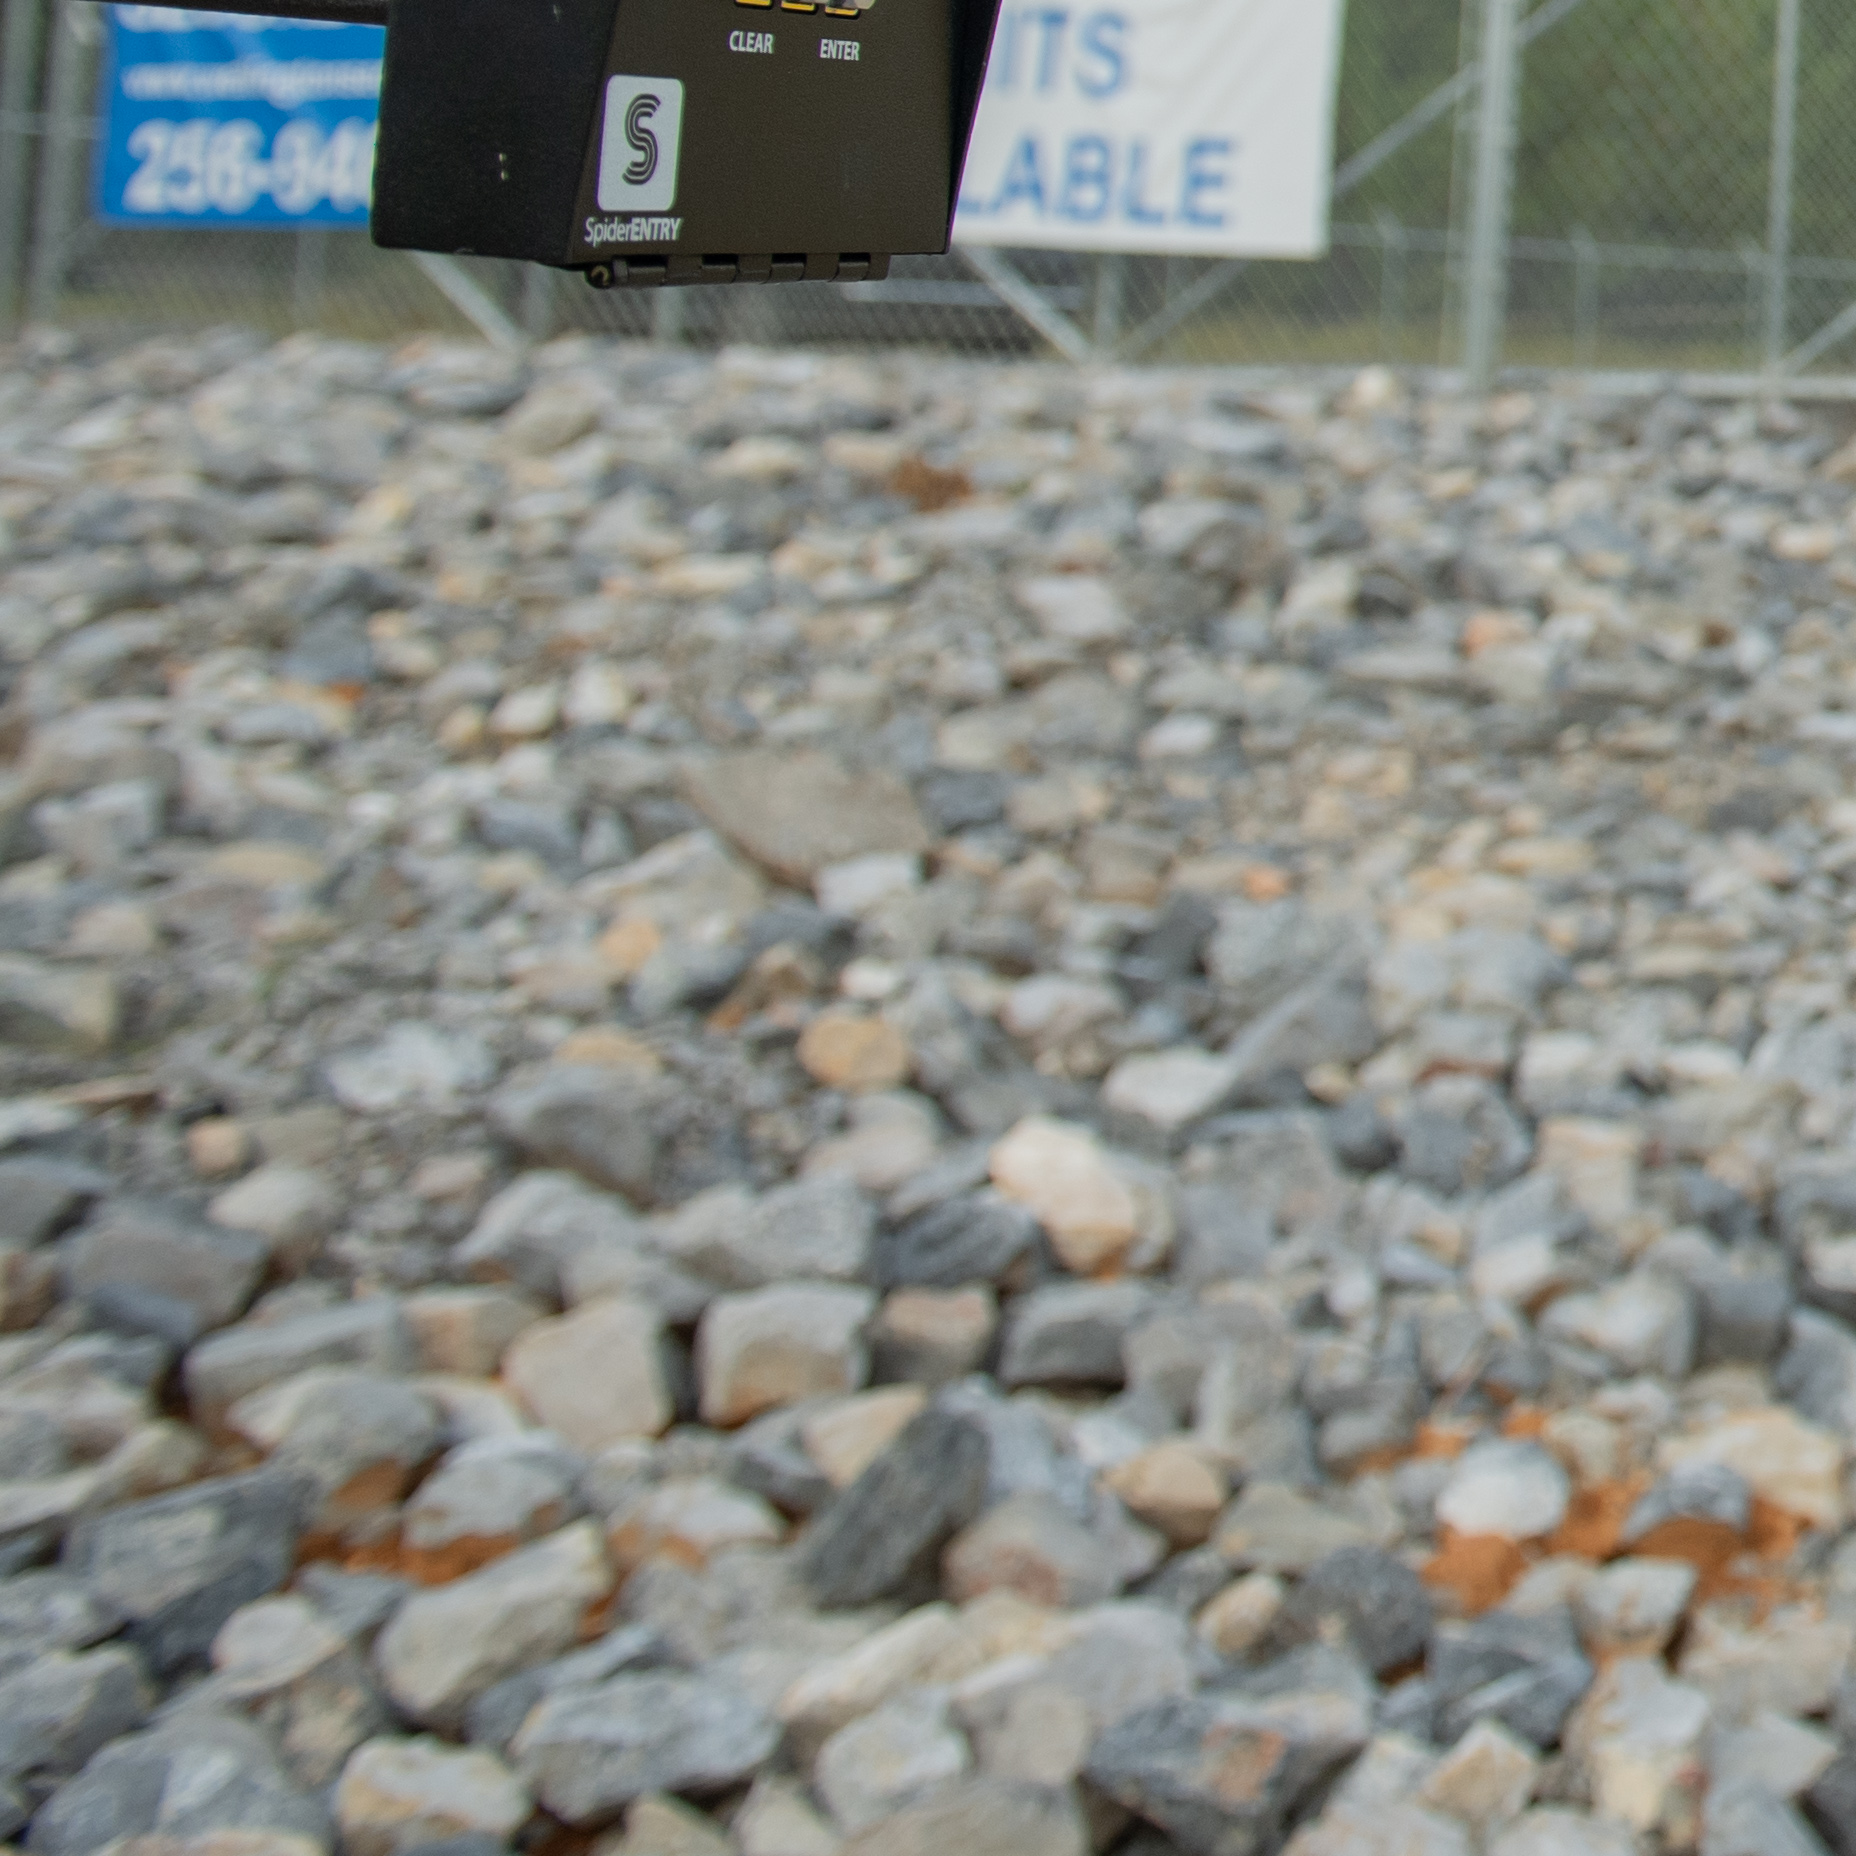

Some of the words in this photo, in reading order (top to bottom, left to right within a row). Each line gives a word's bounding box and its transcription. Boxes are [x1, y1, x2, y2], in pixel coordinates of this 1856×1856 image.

[729, 30, 774, 54] CLEAR
[819, 38, 860, 62] ENTER
[123, 116, 380, 216] 256-94
[584, 216, 682, 248] SpiderENTRY
